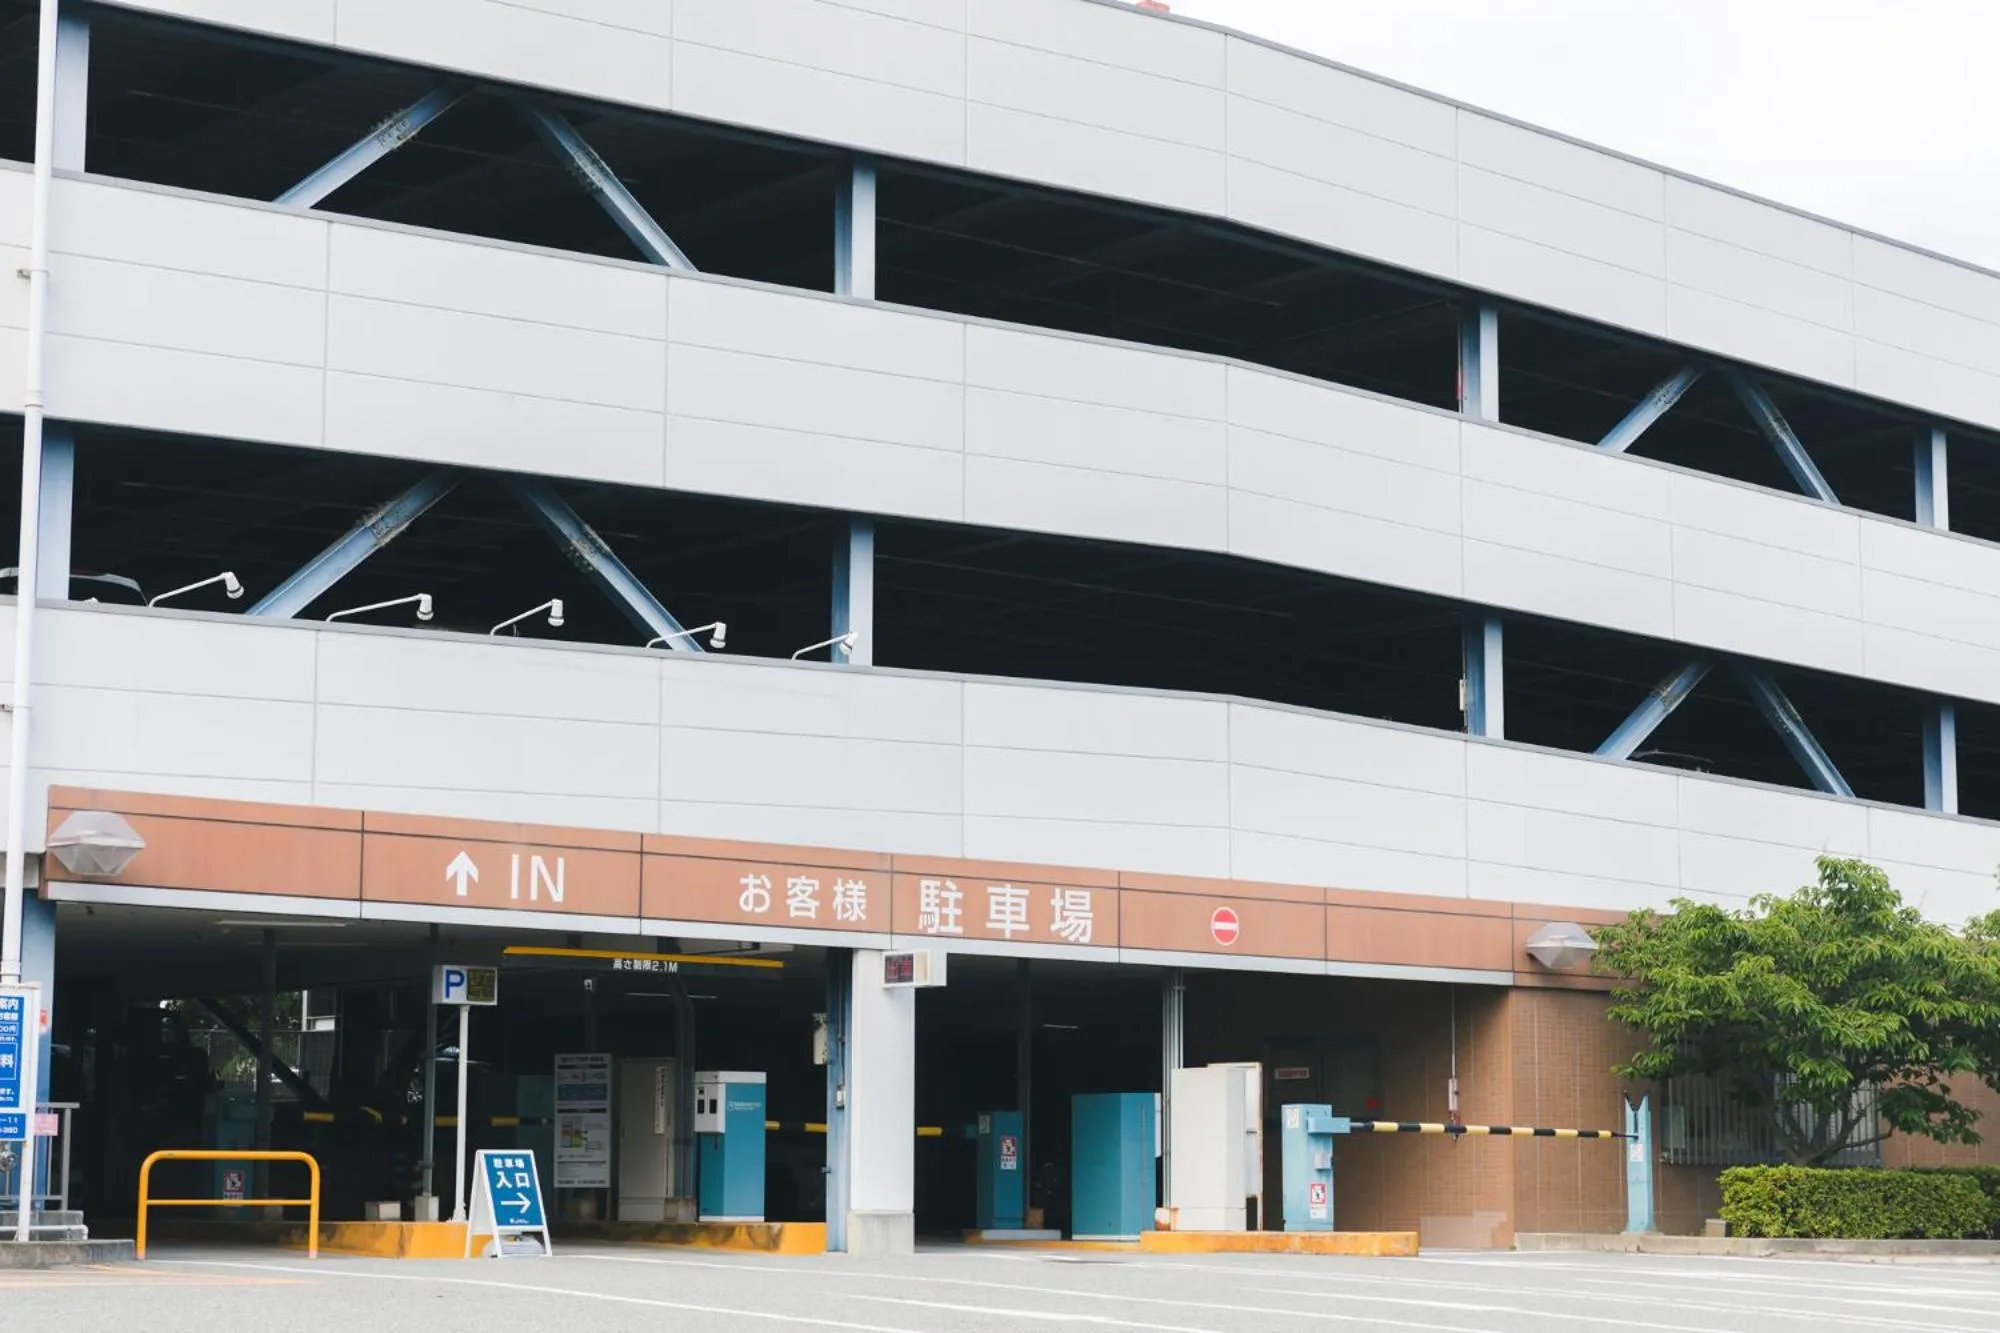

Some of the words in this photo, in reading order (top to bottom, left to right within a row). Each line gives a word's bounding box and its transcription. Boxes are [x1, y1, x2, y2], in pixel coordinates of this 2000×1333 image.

[510, 853, 565, 903] IN
[739, 873, 867, 922] お客様
[918, 879, 1094, 943] 駐車場
[445, 969, 465, 999] P
[496, 1171, 531, 1188] 入口
